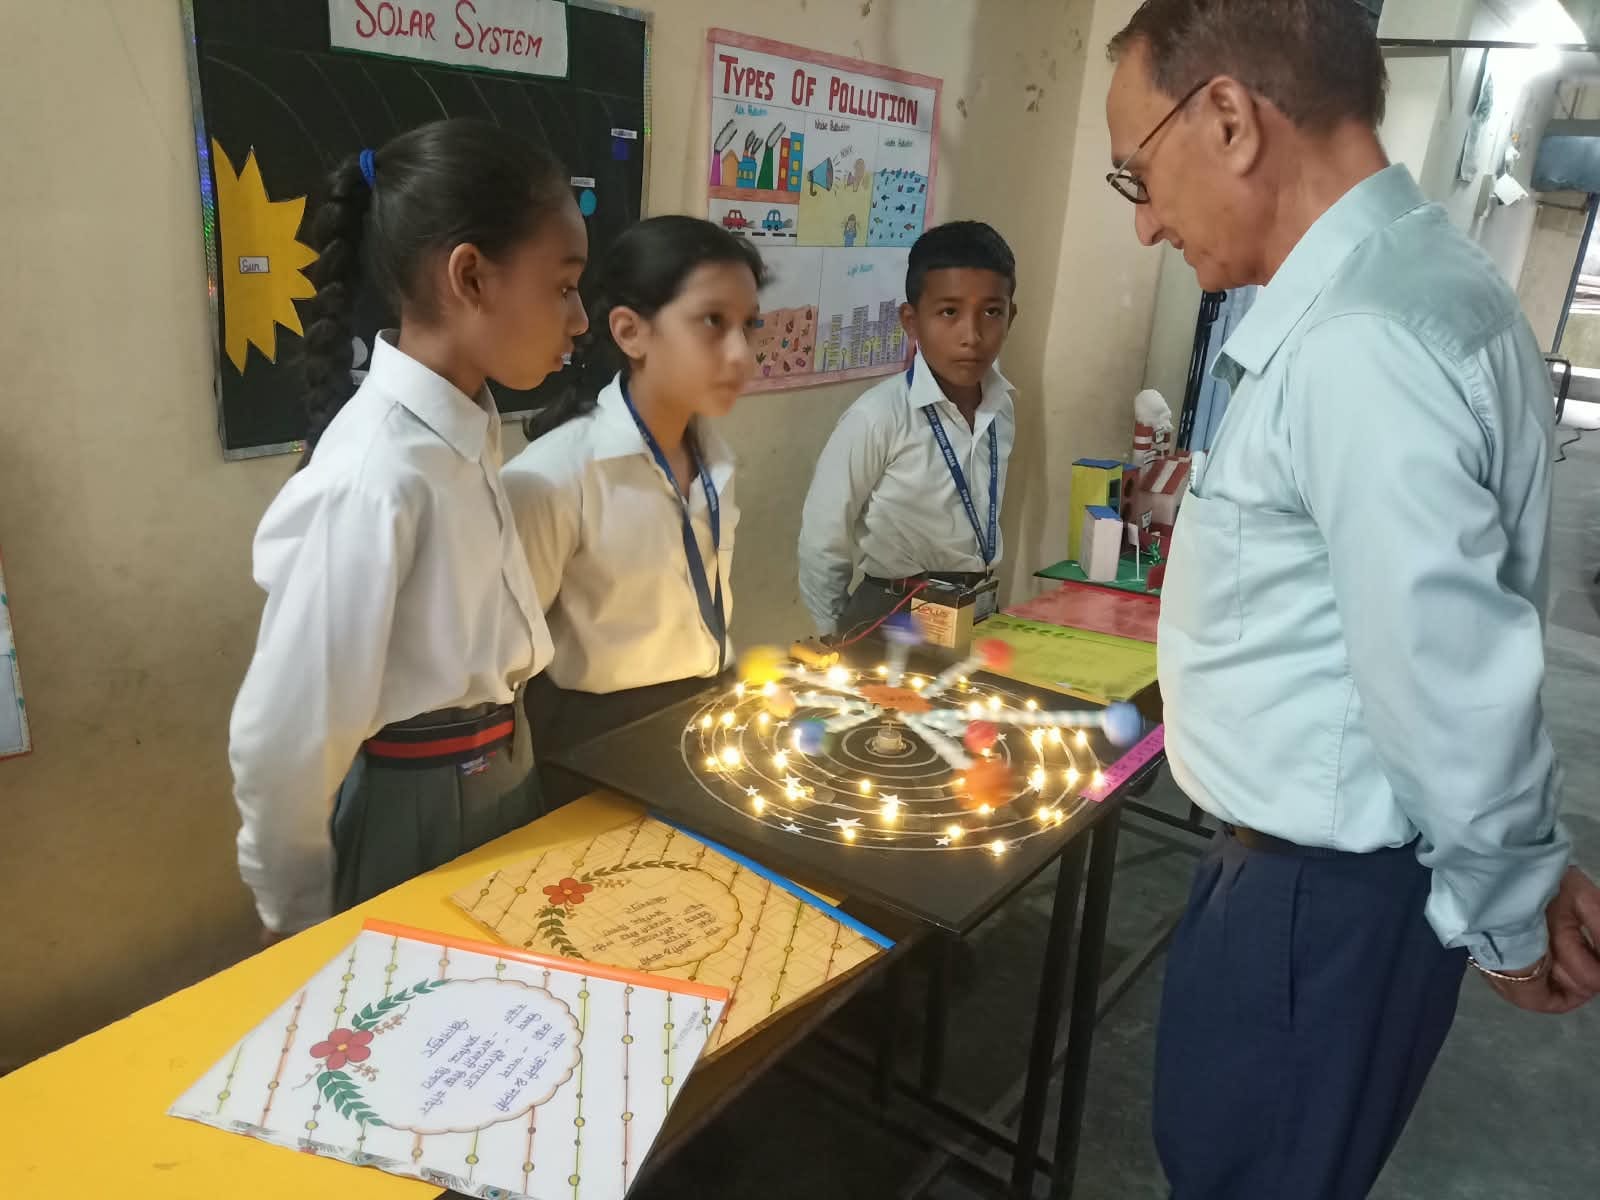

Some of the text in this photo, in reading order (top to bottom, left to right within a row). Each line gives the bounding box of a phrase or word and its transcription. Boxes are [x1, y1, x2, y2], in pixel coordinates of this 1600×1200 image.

[356, 0, 543, 58] SOLAR SYSTEM
[719, 54, 918, 125] TYPES OF POLLUTION
